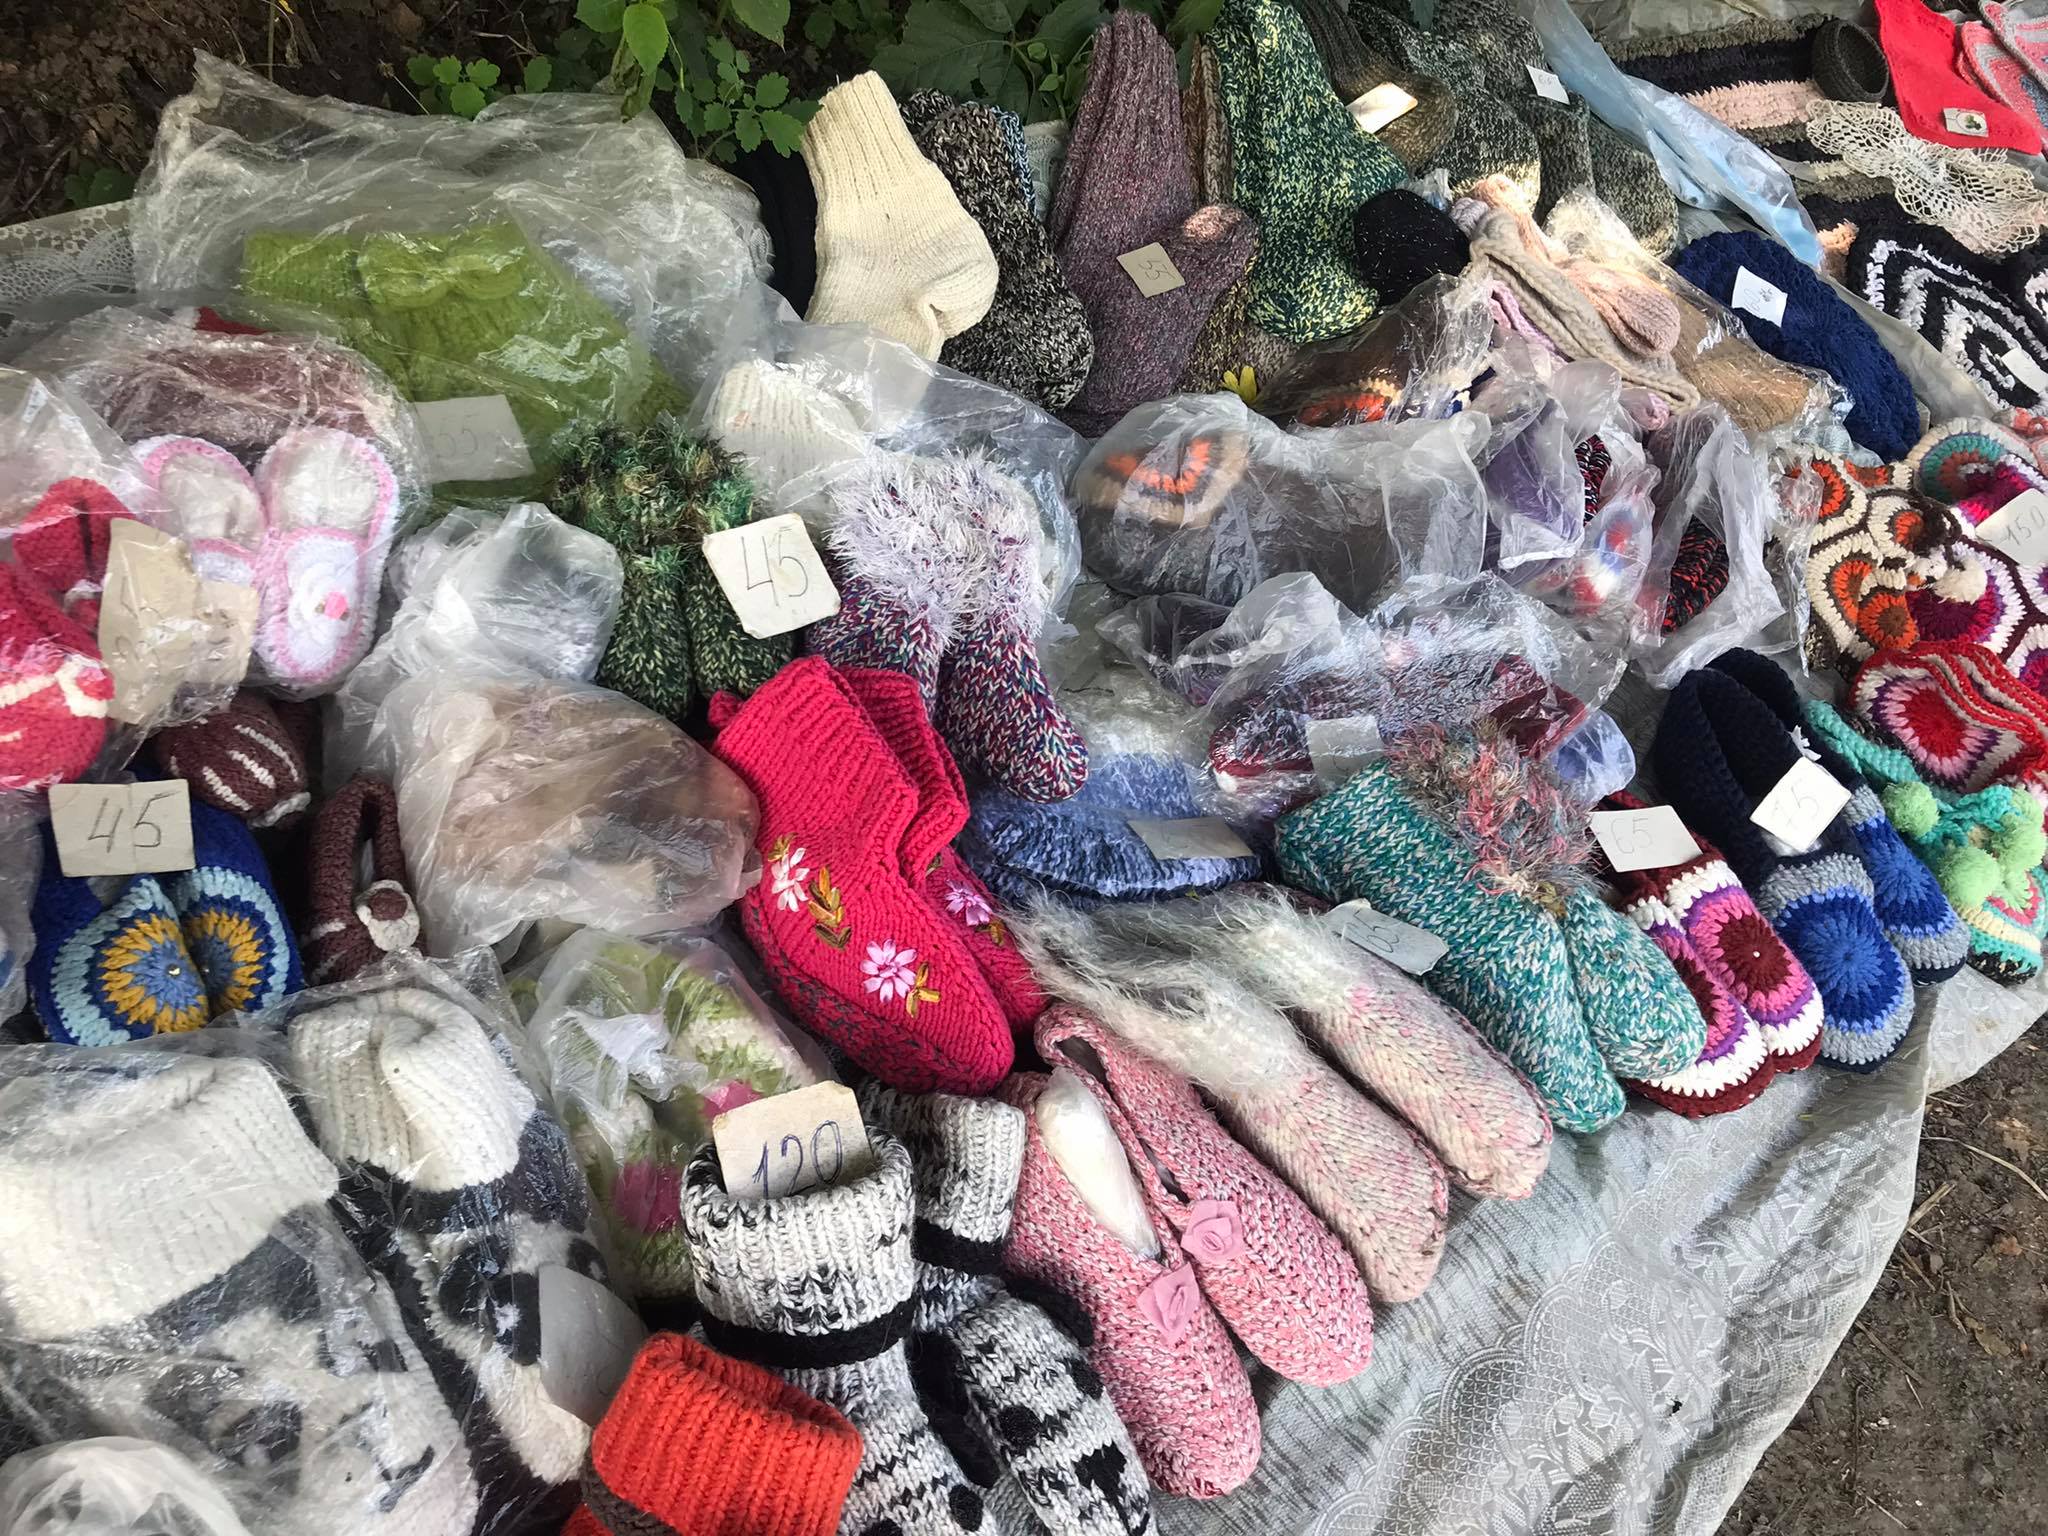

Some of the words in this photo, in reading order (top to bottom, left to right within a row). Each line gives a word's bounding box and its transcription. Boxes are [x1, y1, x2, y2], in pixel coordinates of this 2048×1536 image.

[2000, 504, 2046, 546] 150
[740, 525, 809, 607] 45
[87, 790, 182, 853] 45
[752, 1119, 843, 1200] 120
